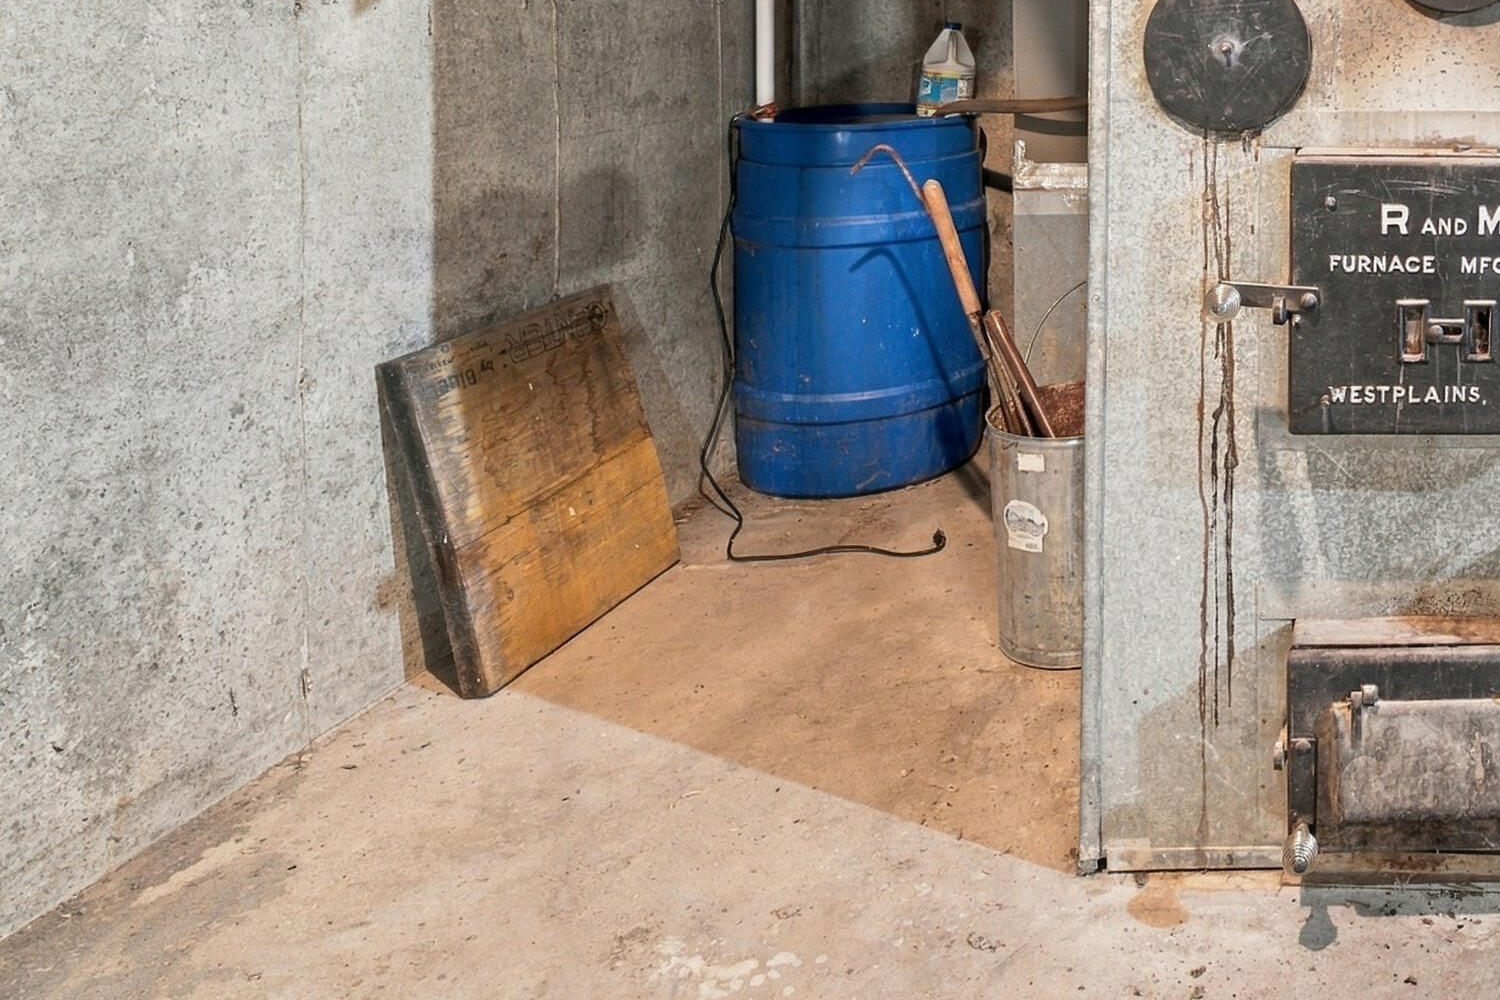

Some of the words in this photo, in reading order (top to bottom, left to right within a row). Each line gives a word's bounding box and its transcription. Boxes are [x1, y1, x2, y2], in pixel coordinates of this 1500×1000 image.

[1382, 204, 1410, 235] R
[1421, 218, 1468, 236] AND
[1329, 255, 1436, 274] FURNACE
[1328, 386, 1487, 406] WESTPLAINS,
